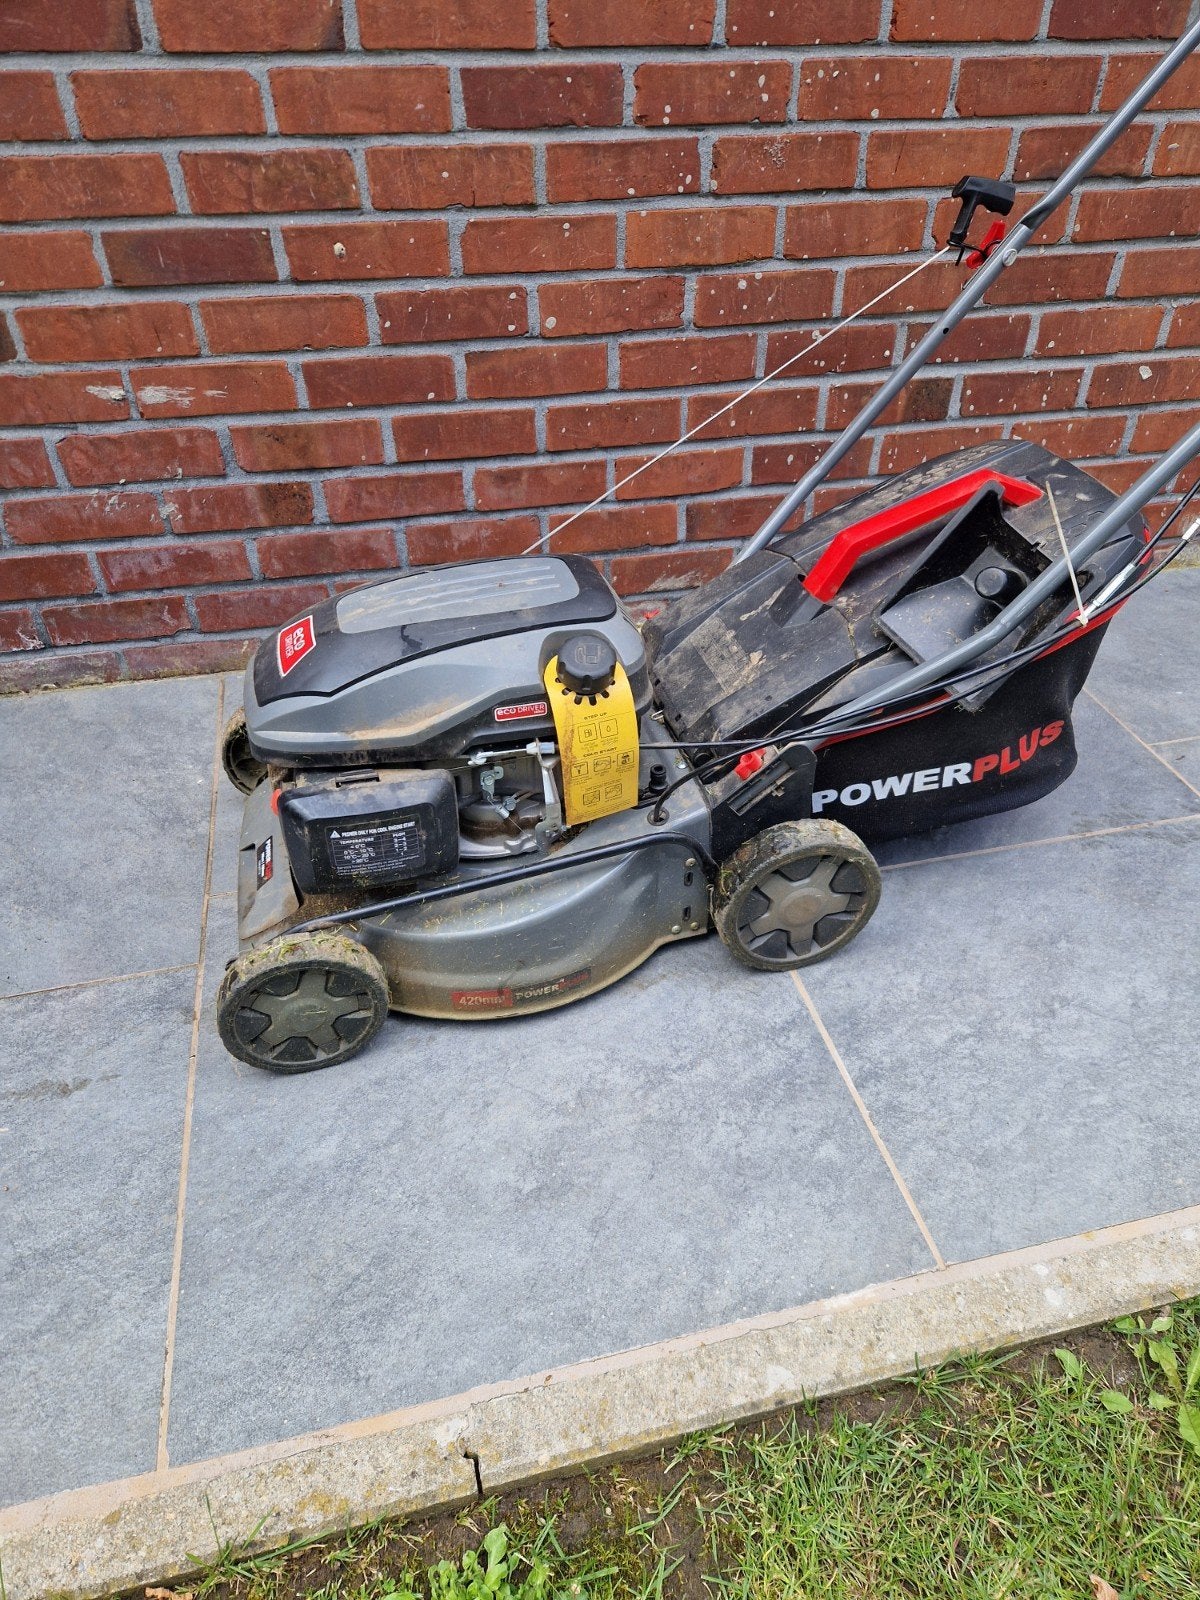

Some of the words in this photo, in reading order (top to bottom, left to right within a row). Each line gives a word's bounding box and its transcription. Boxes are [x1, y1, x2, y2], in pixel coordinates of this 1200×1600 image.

[517, 704, 545, 713] DRIVER
[811, 719, 1065, 814] POWERPLUS
[515, 972, 589, 1000] POWER
